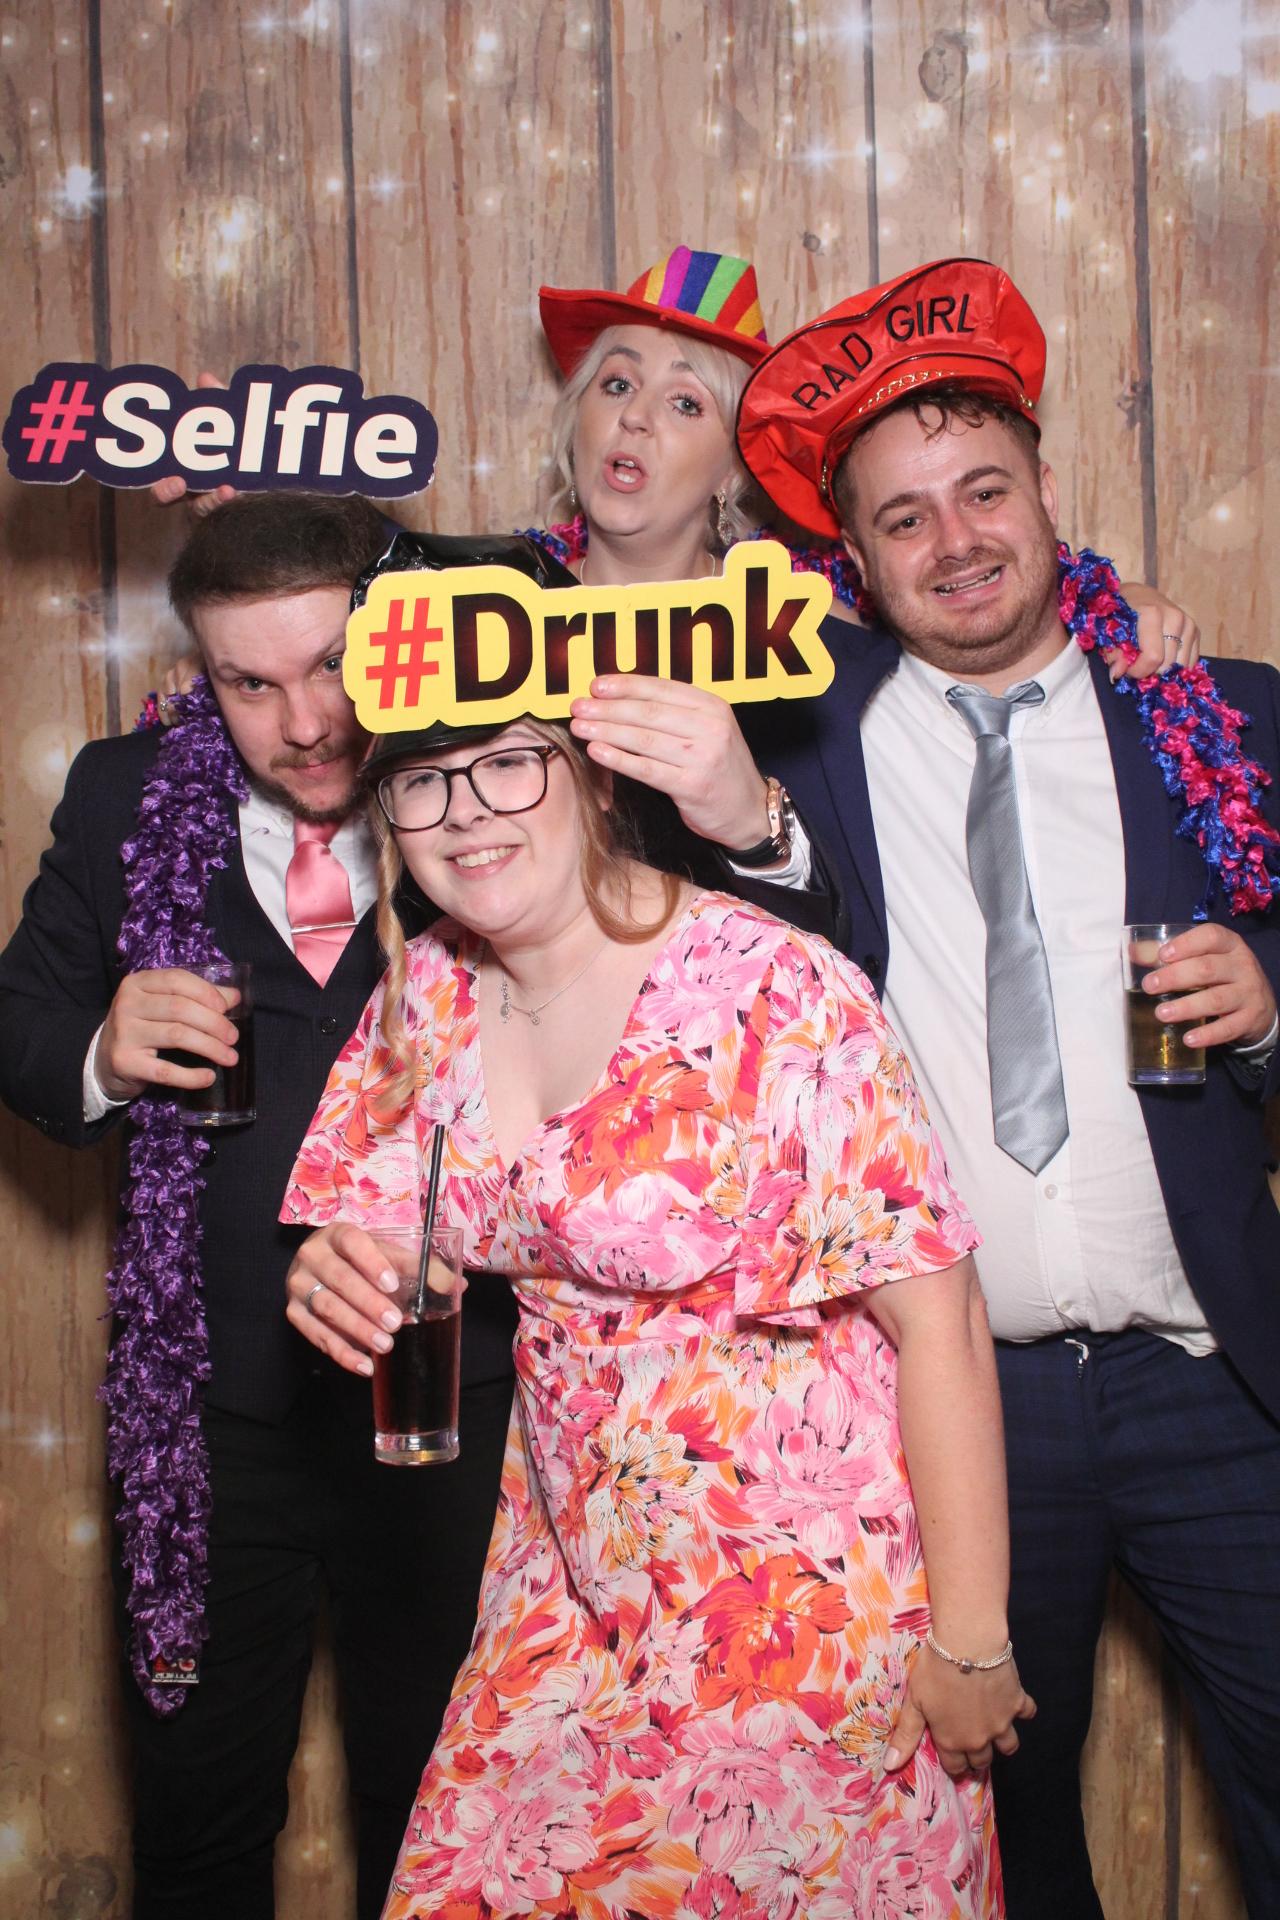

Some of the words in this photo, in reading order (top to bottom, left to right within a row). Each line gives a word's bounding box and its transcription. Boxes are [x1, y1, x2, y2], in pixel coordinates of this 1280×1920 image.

[886, 293, 976, 342] GIRL
[21, 379, 418, 480] #Selfie
[365, 566, 813, 710] #Drunk
